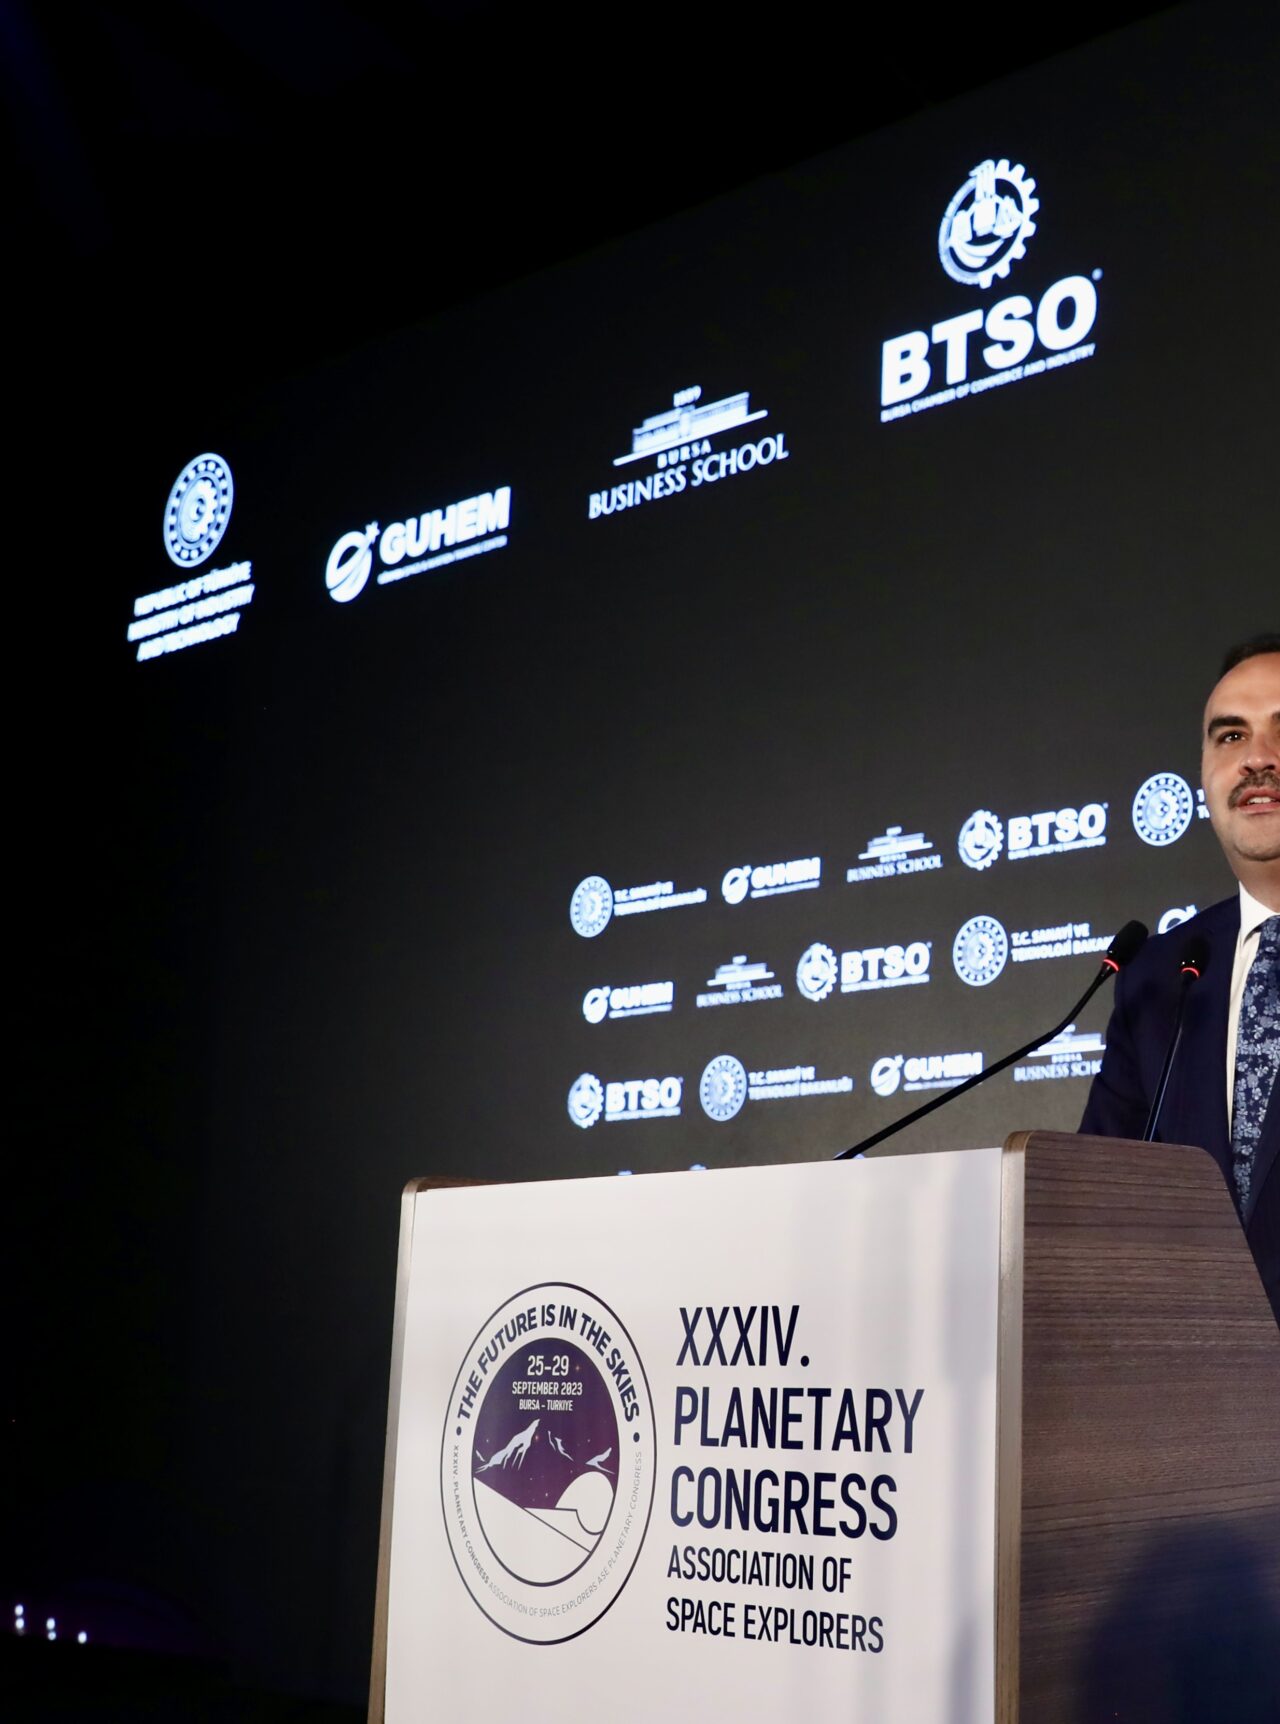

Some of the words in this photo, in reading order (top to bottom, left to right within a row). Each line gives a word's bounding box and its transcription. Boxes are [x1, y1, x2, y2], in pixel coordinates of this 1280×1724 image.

[881, 275, 1098, 407] BTSO
[588, 464, 687, 520] BUSINESS
[691, 433, 789, 487] SCHOOL
[657, 438, 712, 470] BURSA
[379, 486, 511, 565] GUHEM
[1007, 803, 1107, 850] BTSO
[841, 942, 931, 984] BTSO
[605, 1077, 682, 1113] BTSO
[457, 1370, 483, 1420] THE
[477, 1307, 538, 1375] FUTURE
[541, 1303, 556, 1327] IS
[559, 1304, 578, 1331] IN
[579, 1312, 612, 1357] THE
[605, 1347, 640, 1423] SKIES
[676, 1305, 810, 1368] XXXIV.
[512, 1381, 559, 1396] SEPTEMBER
[561, 1382, 583, 1396] 2023
[519, 1398, 541, 1411] BURSA
[673, 1386, 925, 1454] PLANETARY
[670, 1465, 898, 1541] CONGRESS
[453, 1481, 469, 1539] PLANETARY
[465, 1539, 490, 1585] CONGRESS
[667, 1544, 814, 1591] ASSOCIATION
[822, 1556, 852, 1593] OF
[539, 1606, 561, 1618] SPACE
[666, 1596, 735, 1638] SPACE
[743, 1604, 884, 1653] EXPLORERS
